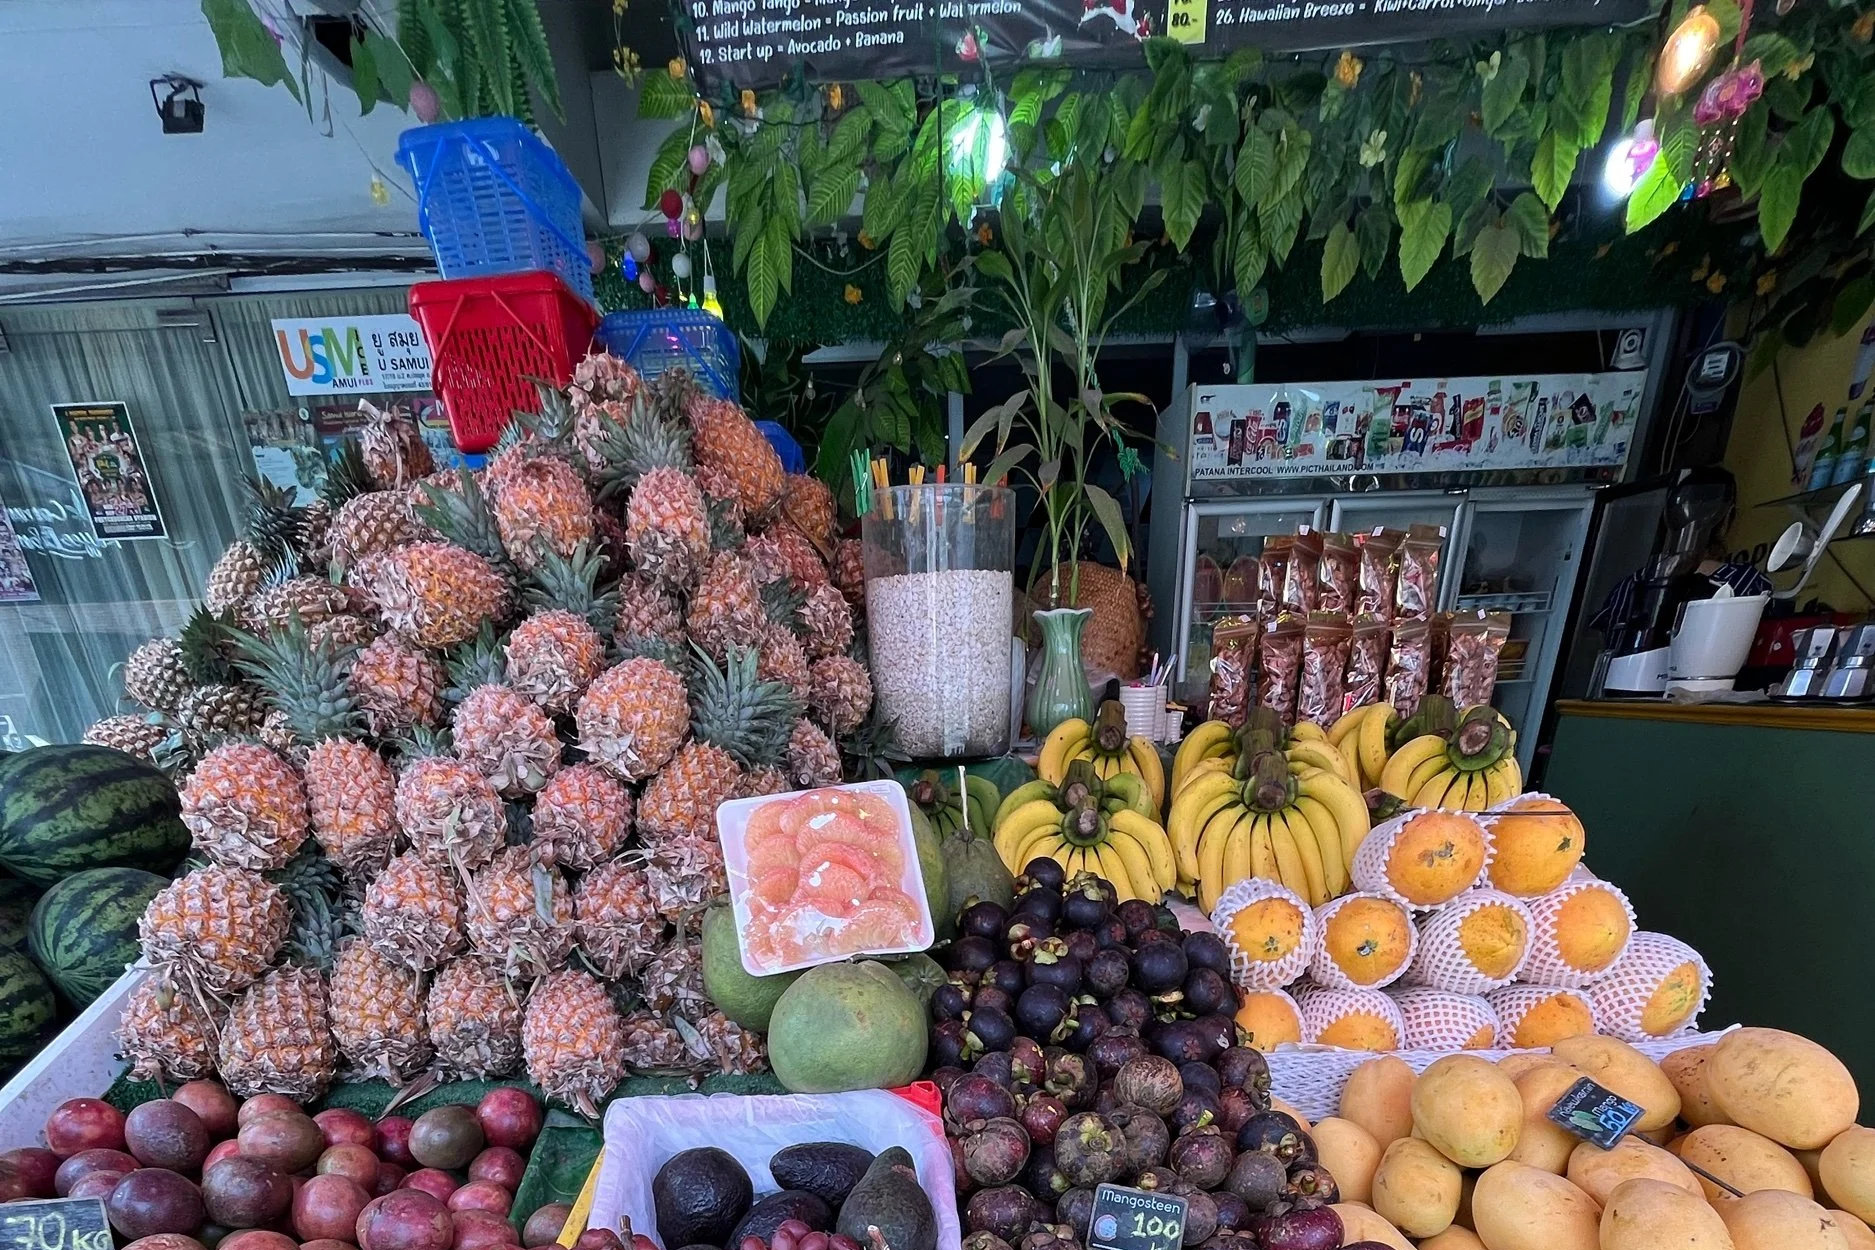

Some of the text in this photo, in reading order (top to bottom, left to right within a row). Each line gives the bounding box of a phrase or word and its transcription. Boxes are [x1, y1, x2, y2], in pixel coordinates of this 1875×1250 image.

[692, 2, 709, 19] 10.
[712, 0, 756, 19] Mango
[696, 25, 710, 42] 11.
[713, 20, 739, 39] Wild
[742, 14, 821, 37] Watermelon
[836, 7, 888, 28] Passion
[892, 3, 924, 22] fruit
[940, 0, 1022, 19] Watrmelon
[1216, 8, 1235, 25] 26.
[1239, 4, 1301, 23] Hawaiian
[1303, 2, 1354, 19] Breeze
[699, 49, 715, 64] 12.
[718, 42, 752, 62] Start
[756, 45, 773, 63] up
[787, 34, 841, 55] Avocado
[855, 31, 904, 48] Banana
[378, 357, 430, 371] U SAMUI
[1195, 463, 1374, 476] PATANA INTERCOOL WWW.PICTHAILAND.OM
[1102, 1190, 1181, 1214] Mangosteen
[1130, 1211, 1180, 1241] 100
